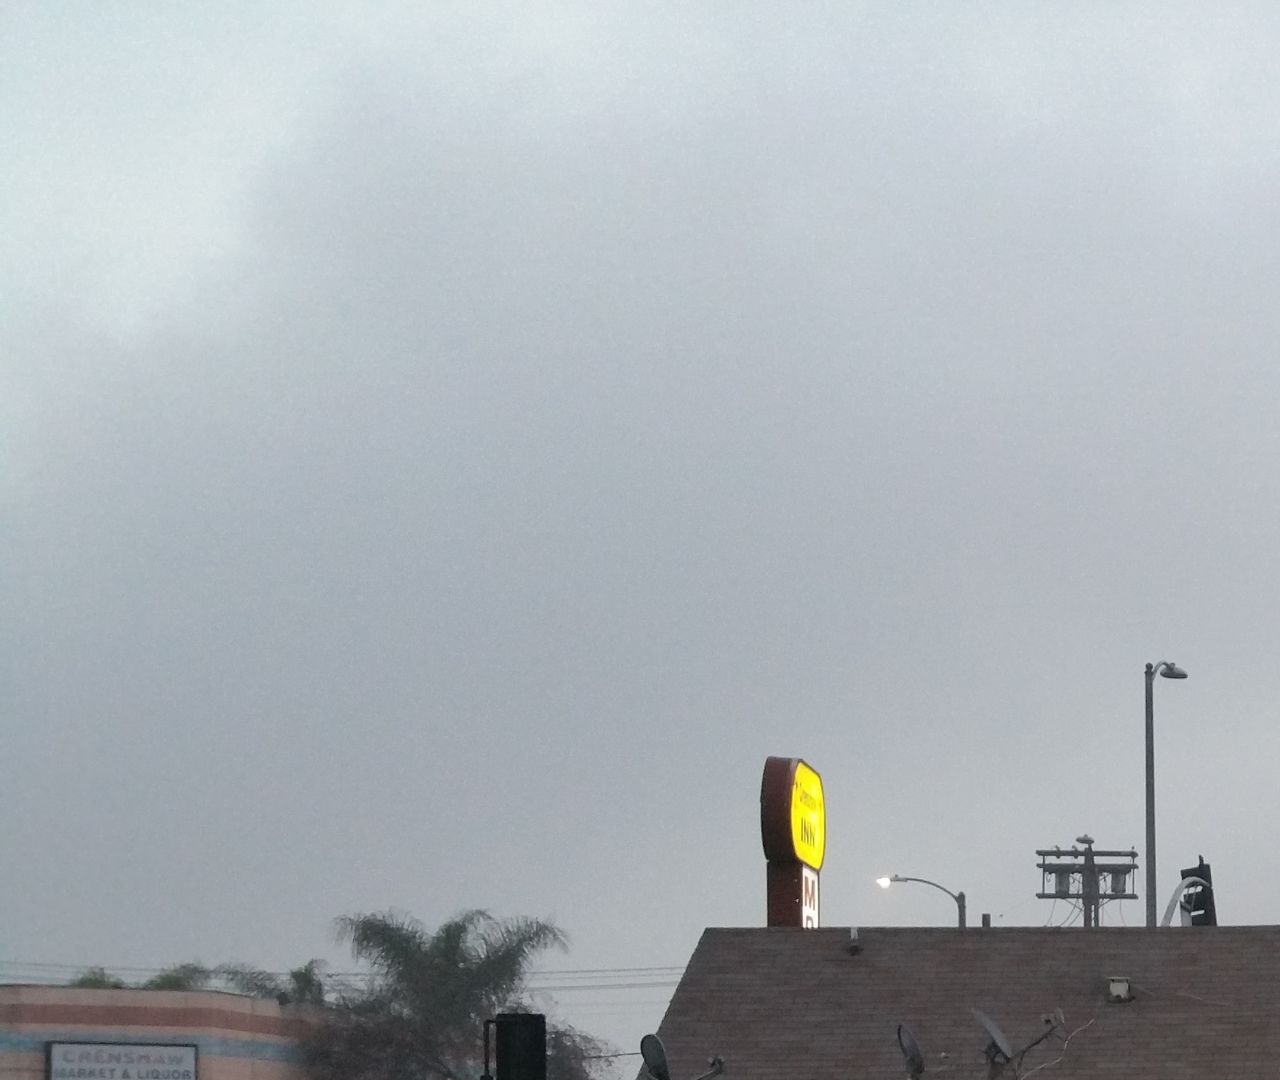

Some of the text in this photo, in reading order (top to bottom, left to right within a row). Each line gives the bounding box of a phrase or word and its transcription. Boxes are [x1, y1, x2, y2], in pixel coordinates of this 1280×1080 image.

[800, 816, 815, 848] INN
[54, 1068, 116, 1080] MARKET
[137, 1069, 192, 1080] LIQUOR
